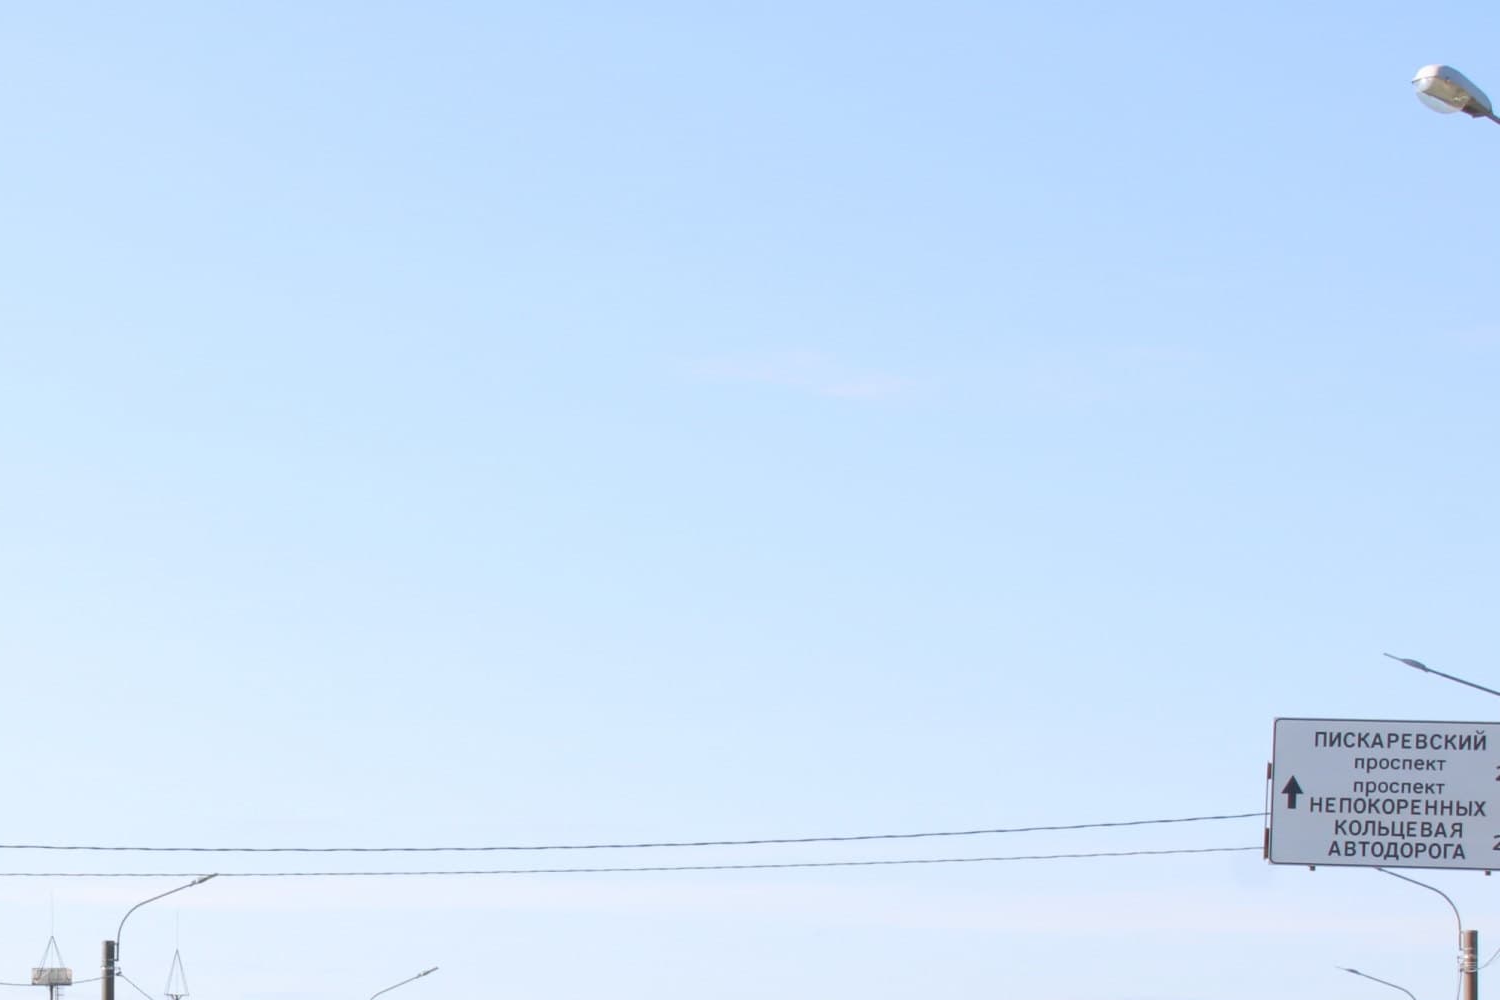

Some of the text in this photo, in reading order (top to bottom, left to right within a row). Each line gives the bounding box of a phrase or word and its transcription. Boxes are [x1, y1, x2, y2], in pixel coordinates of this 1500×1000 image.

[1314, 729, 1487, 751] ПИСКАРЕВСКИЙ
[1354, 756, 1446, 773] проспект
[1353, 780, 1445, 797] проспект
[1309, 797, 1487, 817] НЕПОКОРЕННЫХ
[1334, 819, 1463, 839] КОЛЬЦЕВАЯ
[1328, 841, 1466, 860] АВТОДОРОГА
